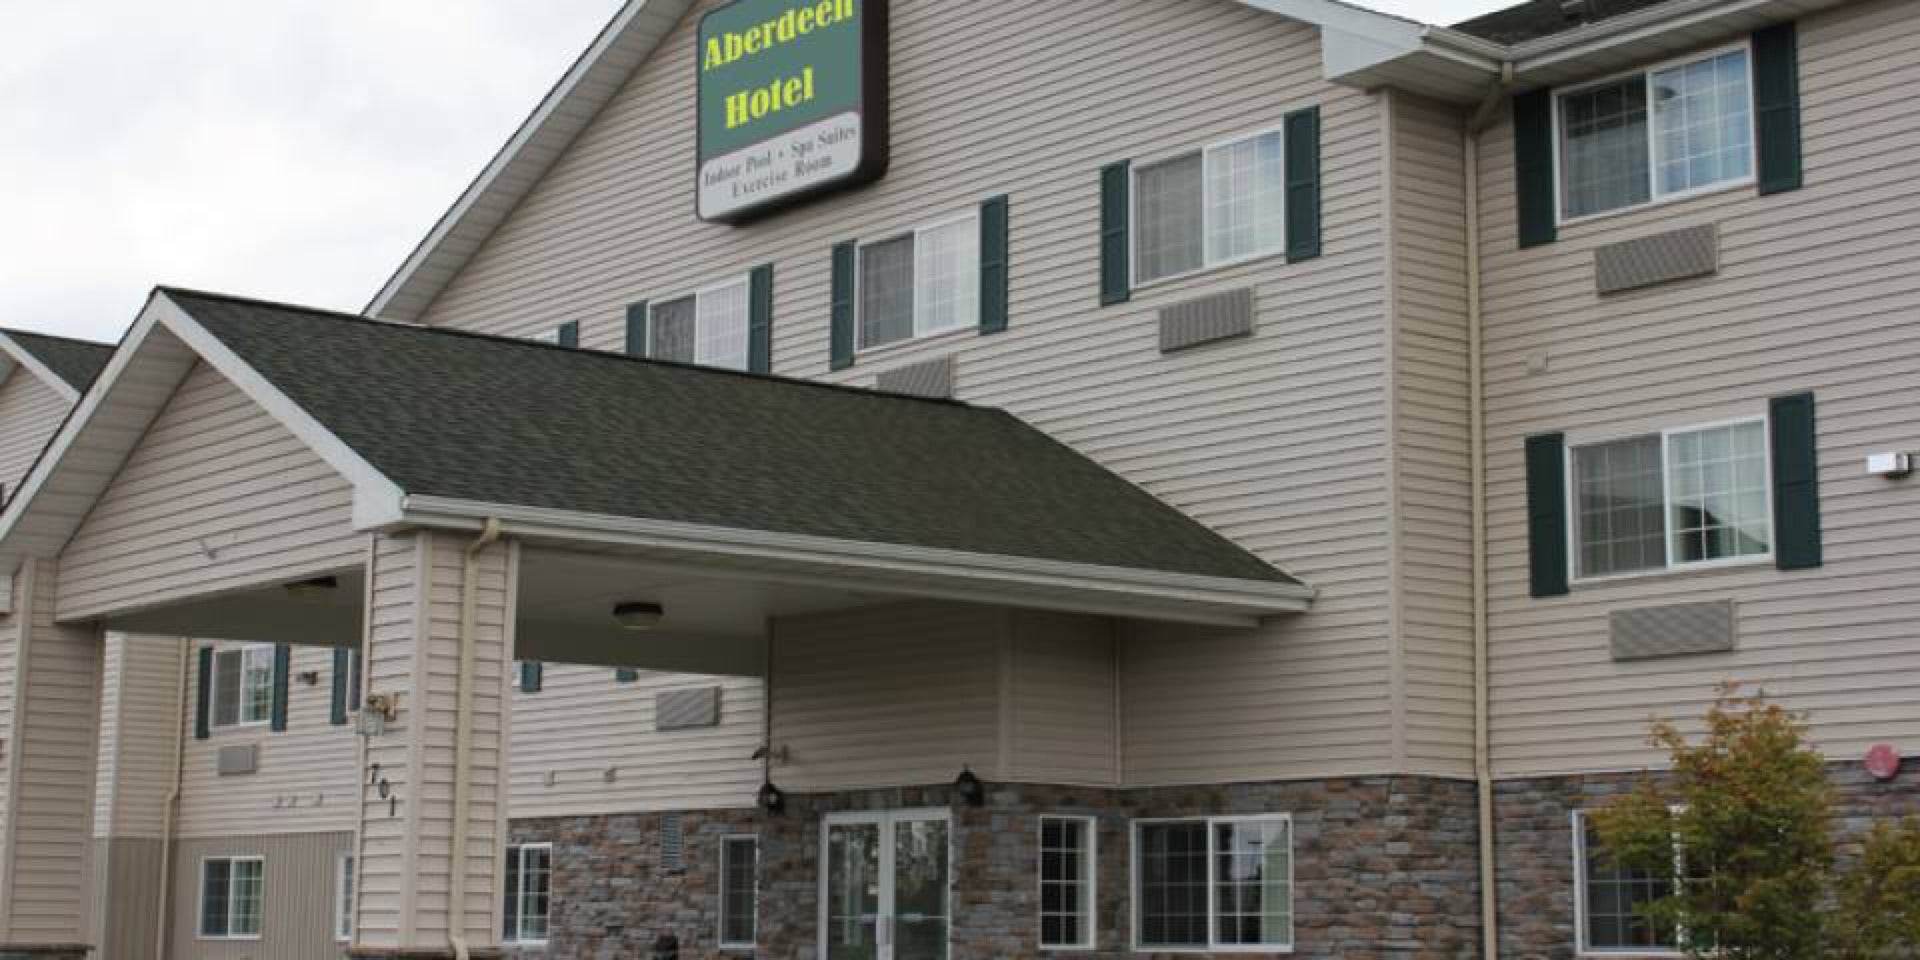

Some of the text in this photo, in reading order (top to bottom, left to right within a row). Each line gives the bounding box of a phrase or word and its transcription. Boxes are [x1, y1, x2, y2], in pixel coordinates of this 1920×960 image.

[704, 0, 853, 70] Aberdeen
[725, 65, 814, 128] Hotel
[705, 126, 857, 186] Indoor Pool Spa Suites
[732, 155, 832, 197] Exercise Room
[371, 763, 396, 817] 701
